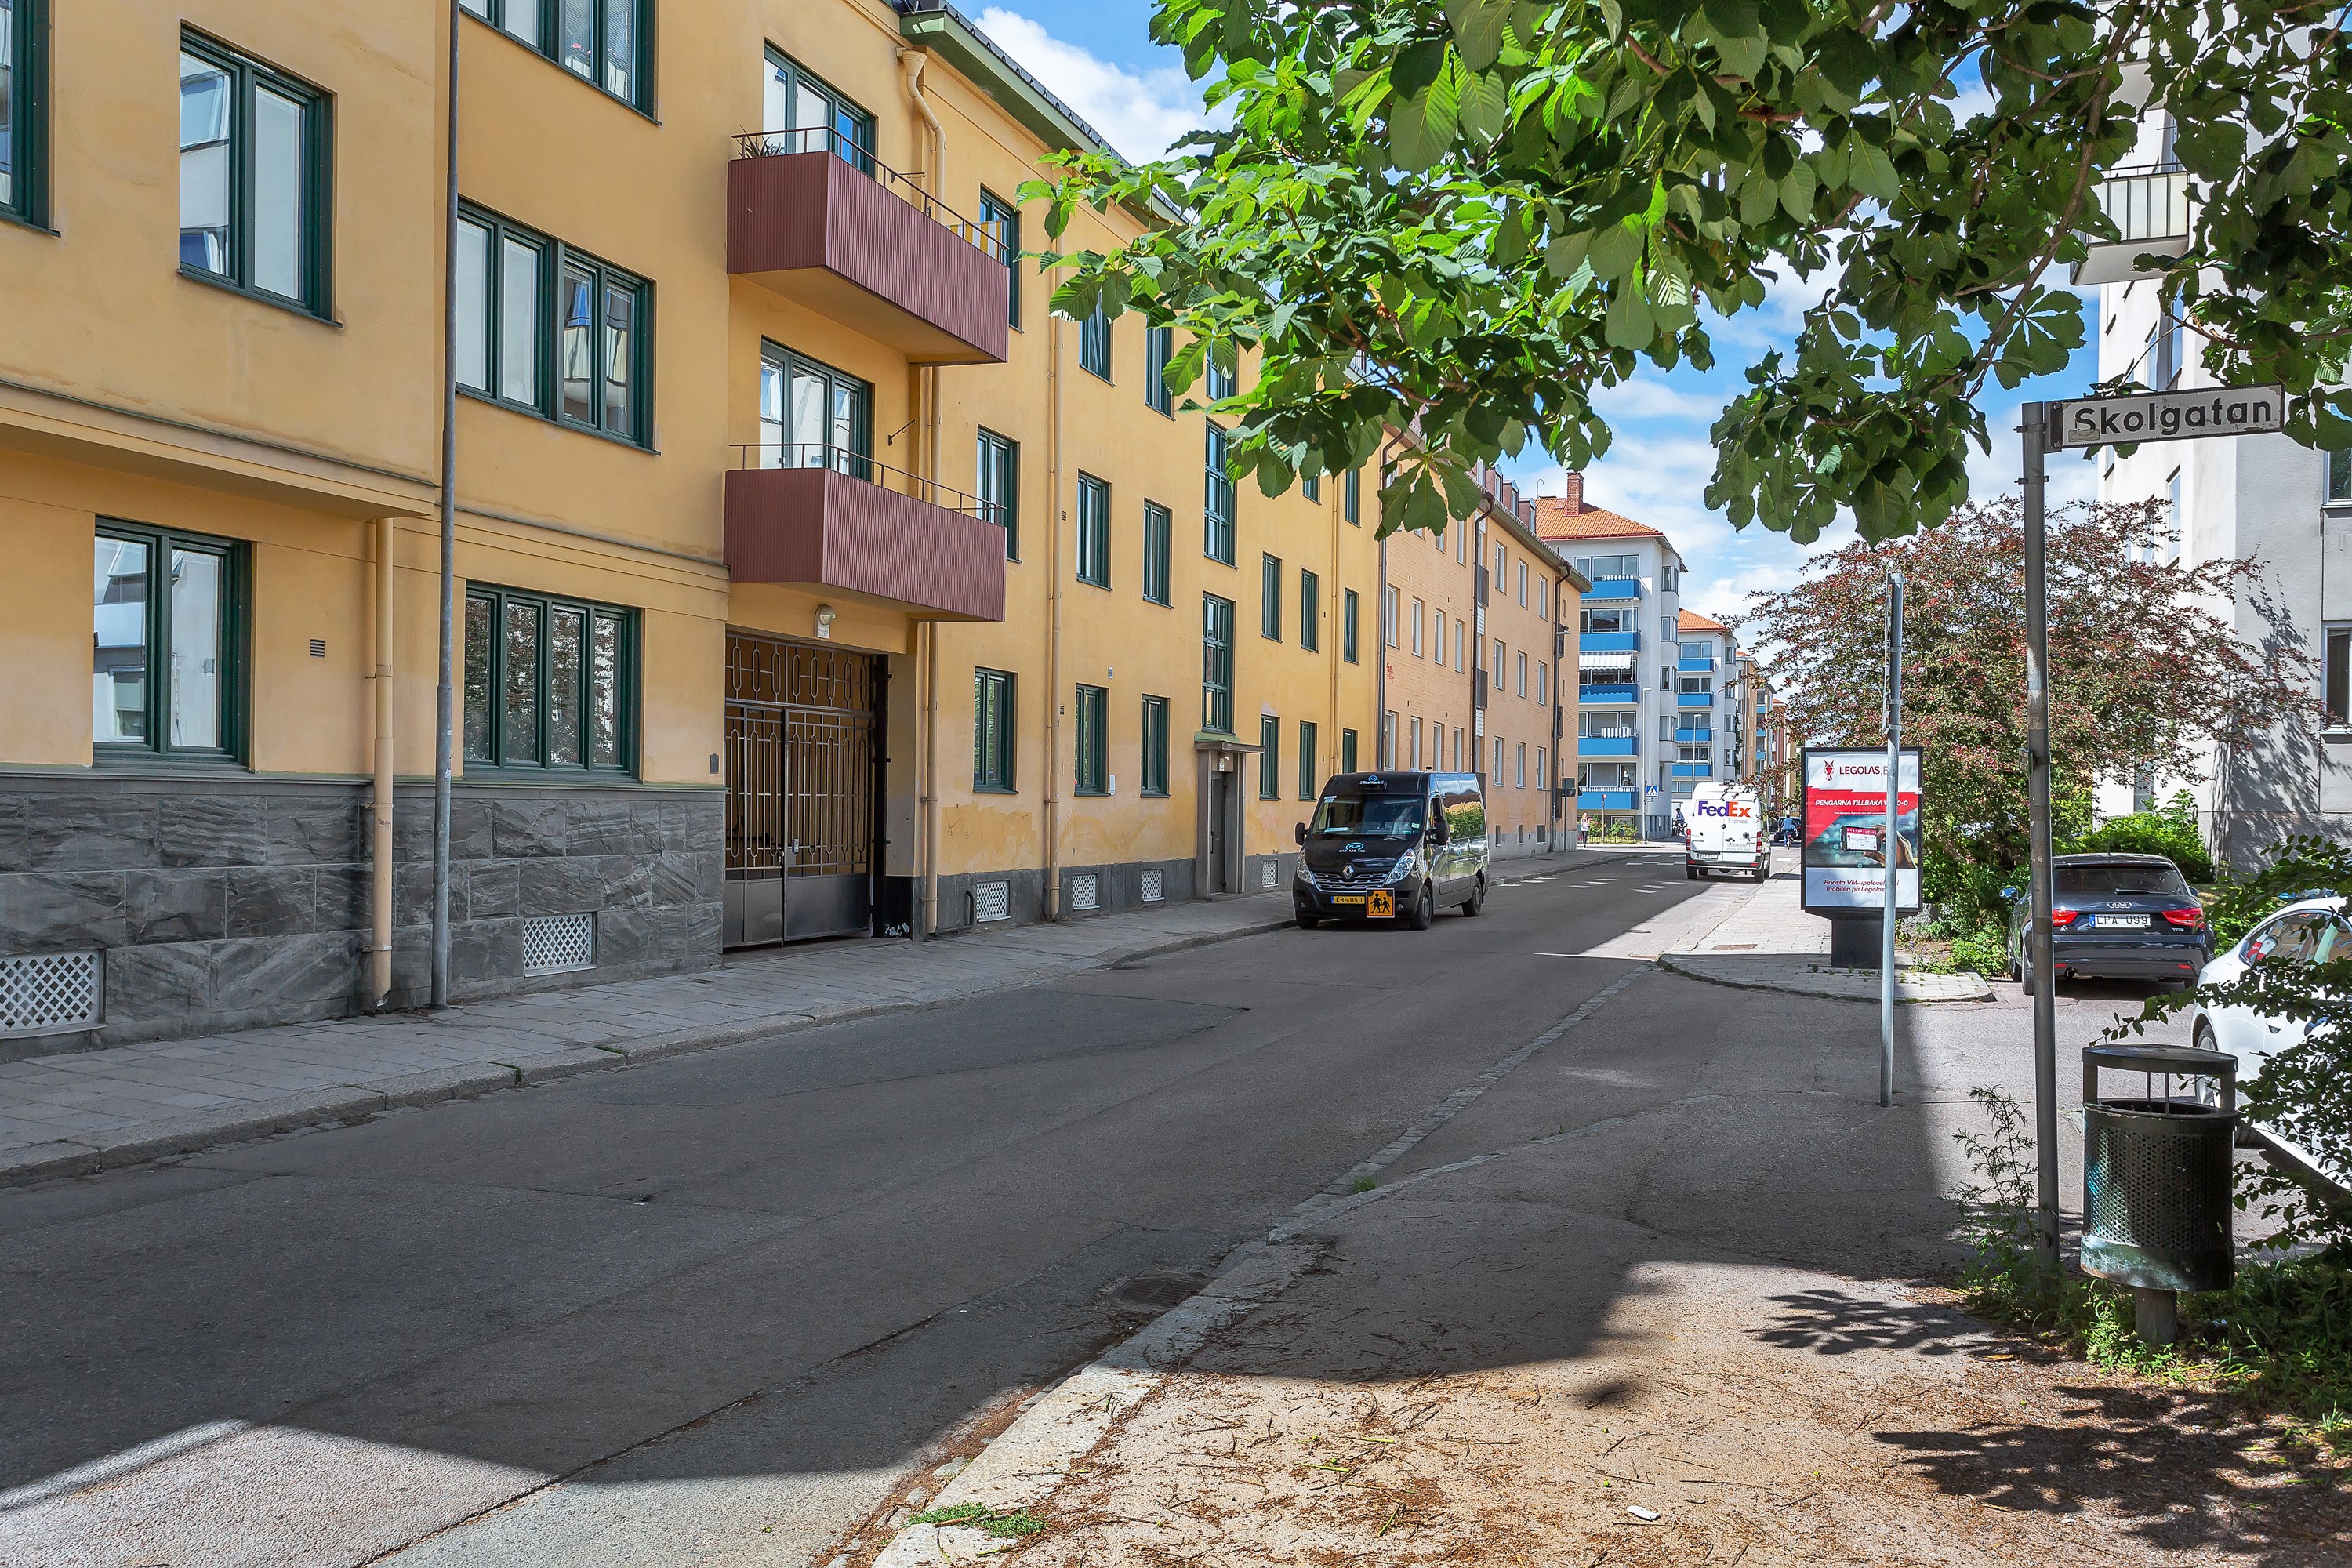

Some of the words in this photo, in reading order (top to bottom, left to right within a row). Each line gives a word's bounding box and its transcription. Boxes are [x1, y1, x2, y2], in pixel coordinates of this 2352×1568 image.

[2074, 397, 2272, 435] Skolgatan
[1839, 765, 1888, 775] LEGOLAS.B
[1697, 800, 1751, 818] FedEx
[2096, 916, 2118, 924] LPA
[2125, 916, 2148, 924] 099
